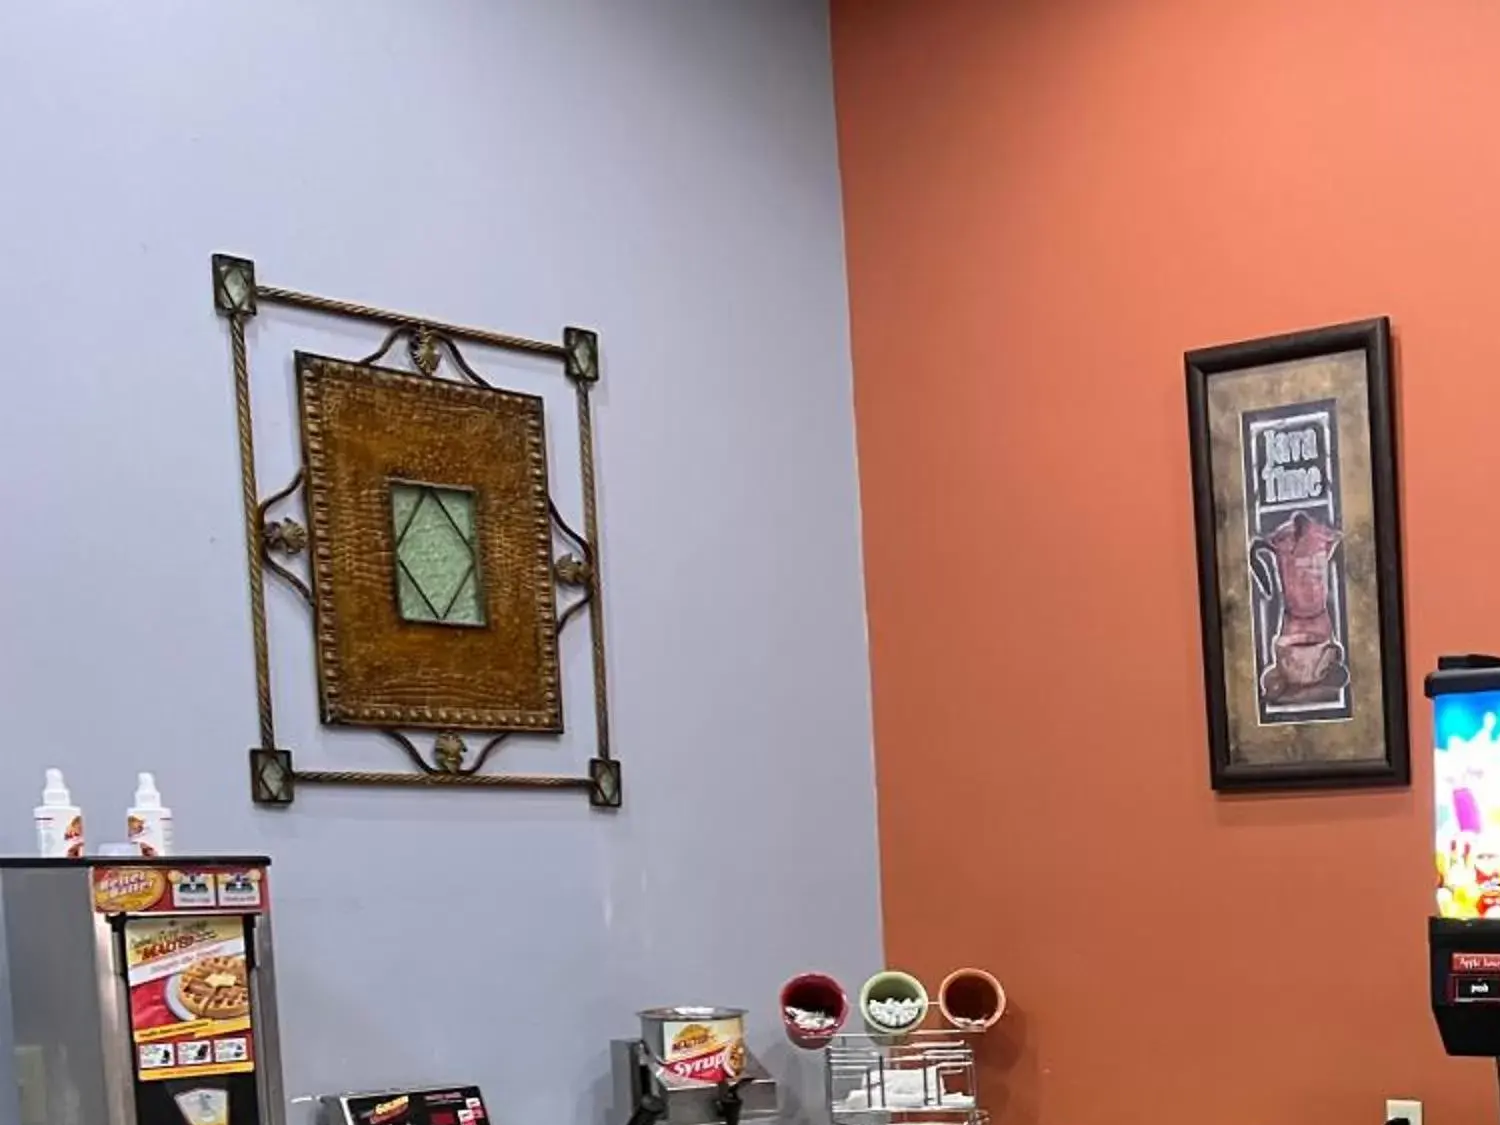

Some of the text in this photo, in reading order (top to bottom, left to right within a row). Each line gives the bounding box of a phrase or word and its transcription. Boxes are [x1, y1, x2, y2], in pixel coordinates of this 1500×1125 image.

[1263, 428, 1319, 466] Java
[1261, 465, 1322, 502] Time
[673, 1052, 726, 1078] Syrup
